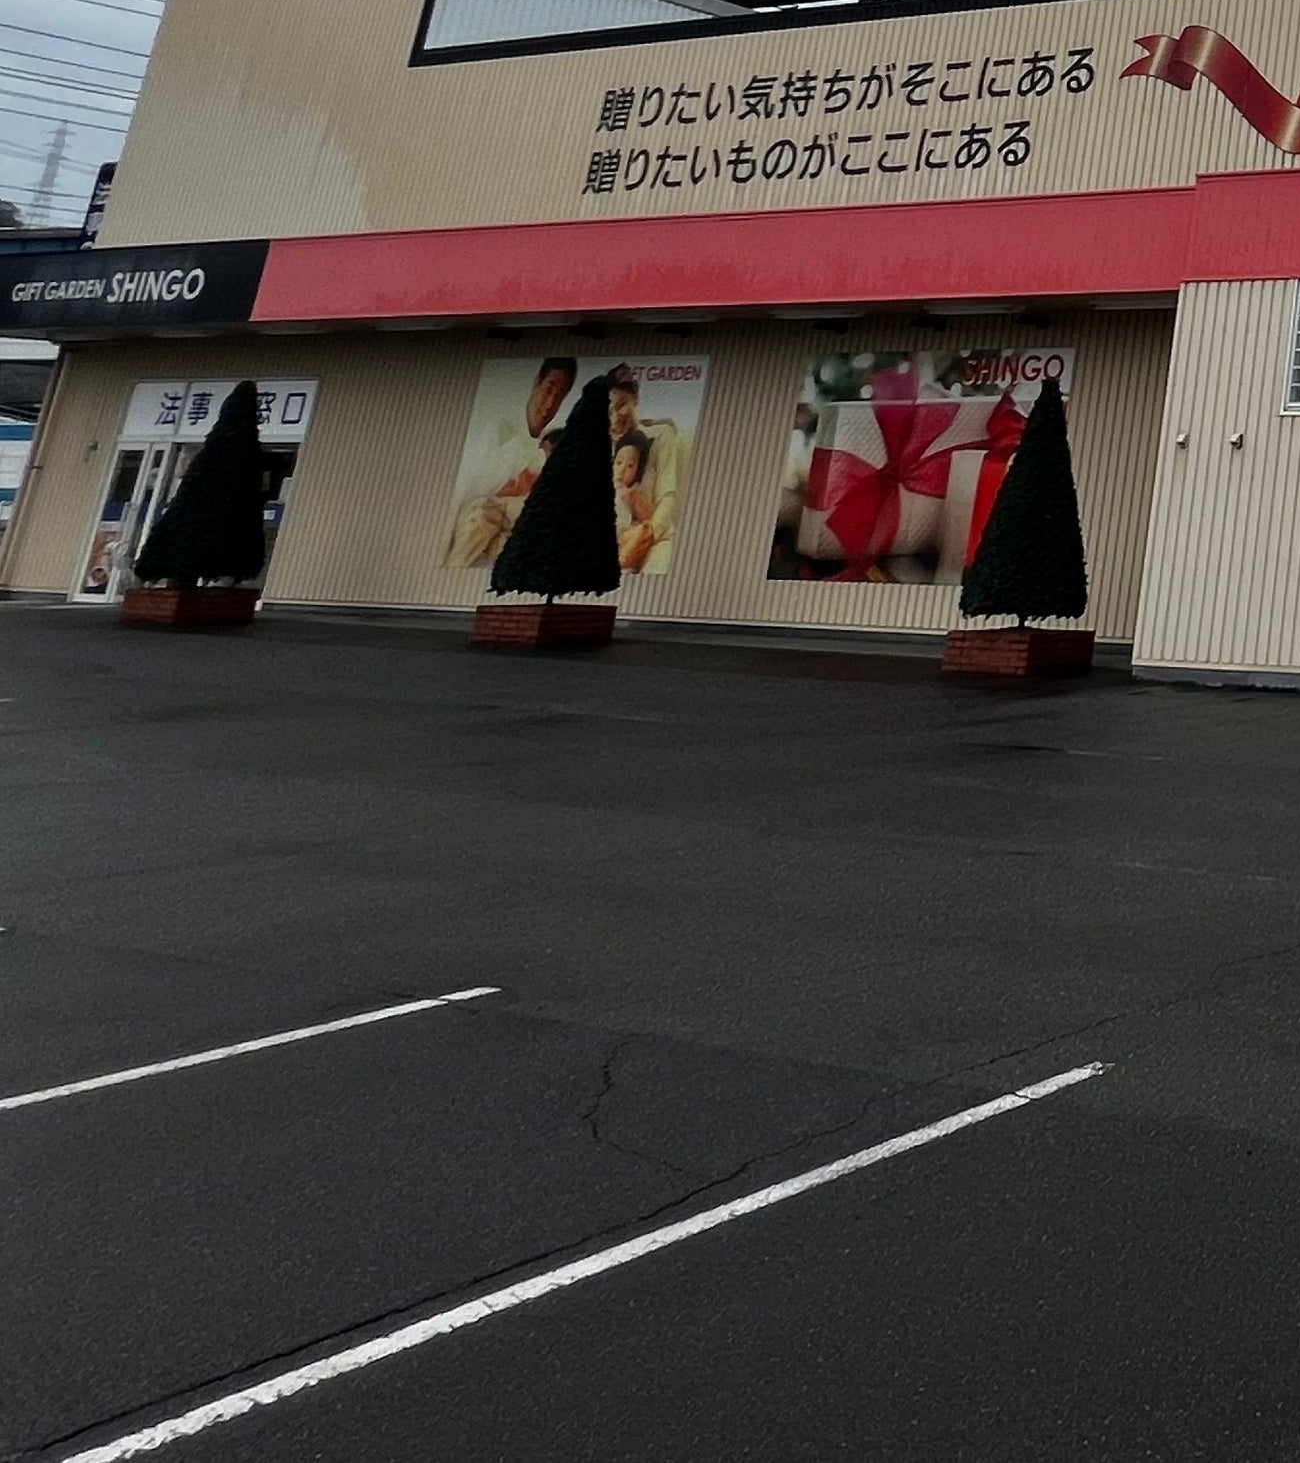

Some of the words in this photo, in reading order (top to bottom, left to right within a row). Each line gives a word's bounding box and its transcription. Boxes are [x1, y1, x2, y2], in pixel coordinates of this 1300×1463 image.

[596, 47, 1095, 132] 贈りたい気持ちがそこにある
[582, 121, 1031, 195] 贈りたいものがここにある
[11, 281, 45, 302] GIFT
[45, 278, 107, 301] GARDEN
[106, 268, 205, 303] SHINGO
[647, 365, 702, 381] GARDEN
[962, 354, 1064, 385] SHINGO
[154, 391, 307, 426] 法事窓口
